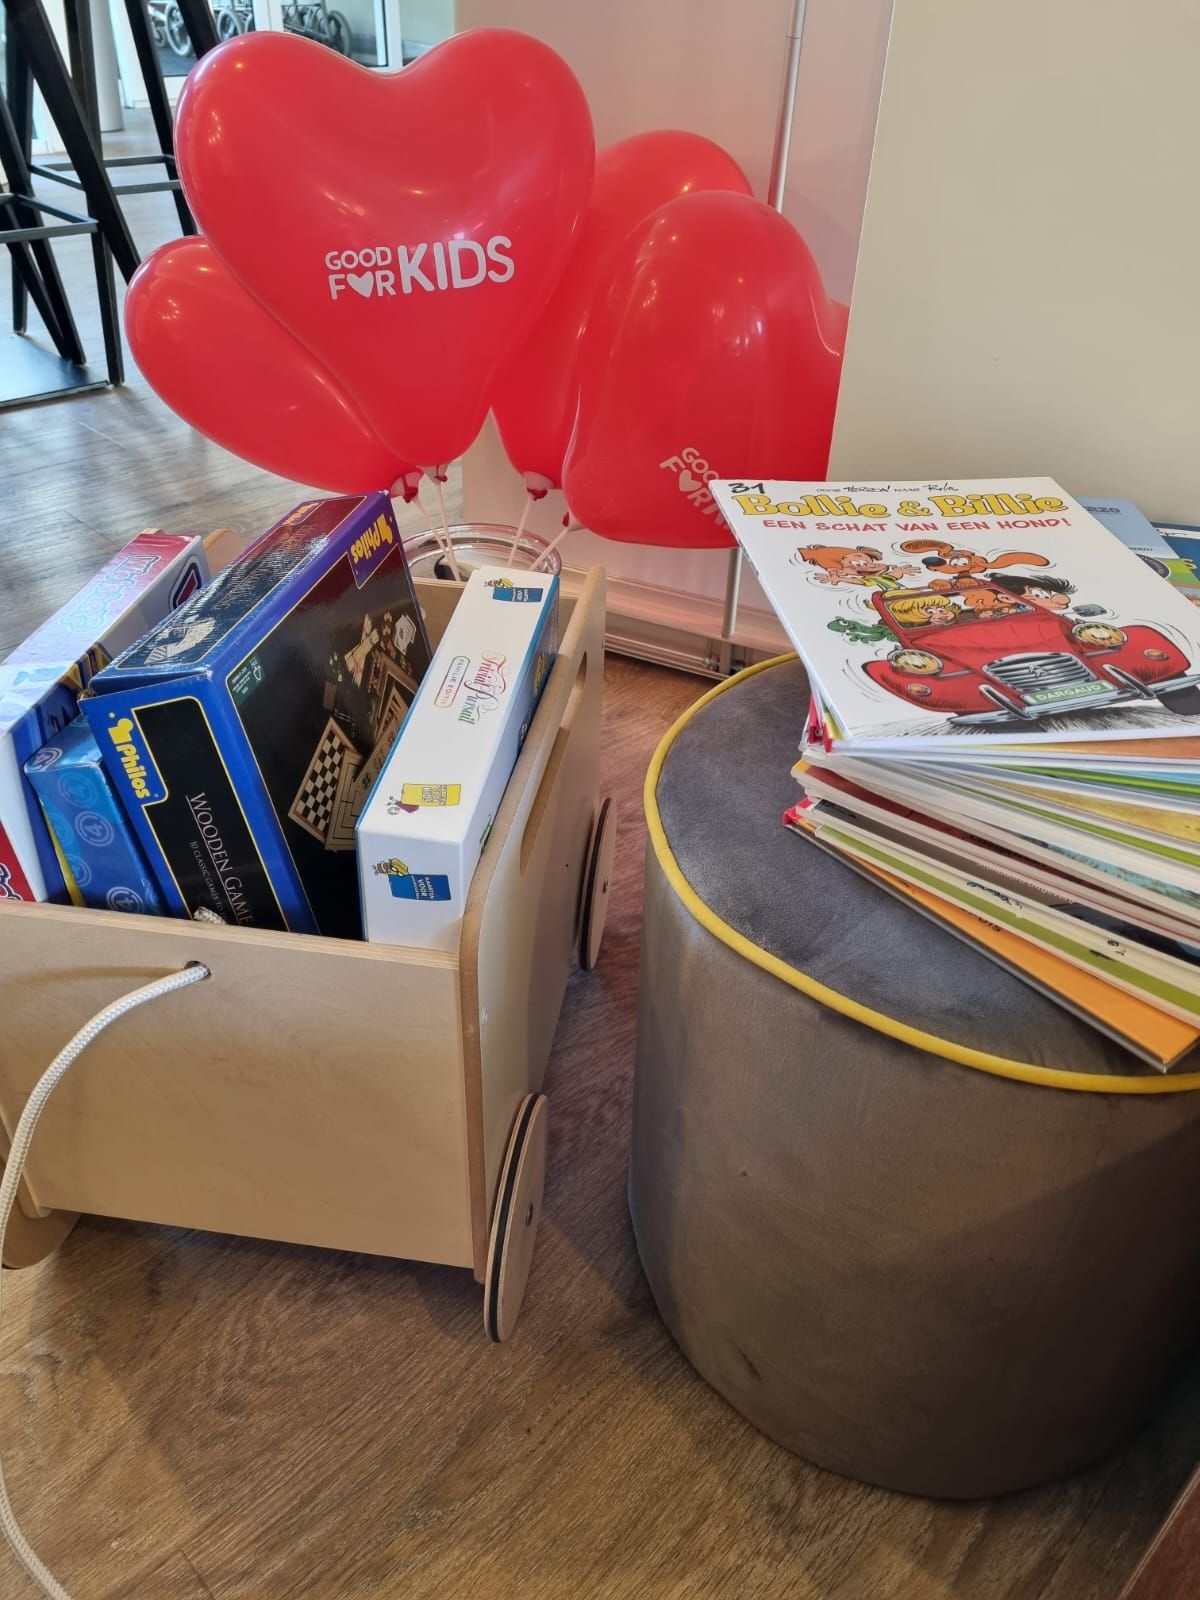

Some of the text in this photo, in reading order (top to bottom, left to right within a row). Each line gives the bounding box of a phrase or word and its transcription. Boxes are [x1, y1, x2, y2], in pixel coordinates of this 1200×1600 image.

[324, 246, 393, 271] GOOD
[397, 235, 515, 294] KIDS
[682, 447, 720, 484] GOO
[728, 482, 766, 494] 31
[731, 494, 891, 518] Bollie
[897, 500, 933, 517] &
[928, 493, 1069, 517] Billie
[763, 517, 1072, 532] EEN SCHAT VAN EEN HOND!
[458, 650, 506, 724] Trivial Pursuit
[1035, 684, 1101, 701] DARGAUD
[116, 743, 151, 799] Philos
[190, 792, 233, 872] WOODEN
[193, 850, 210, 877] CLASSIC
[204, 877, 219, 900] GAMES
[418, 879, 428, 897] VOOR
